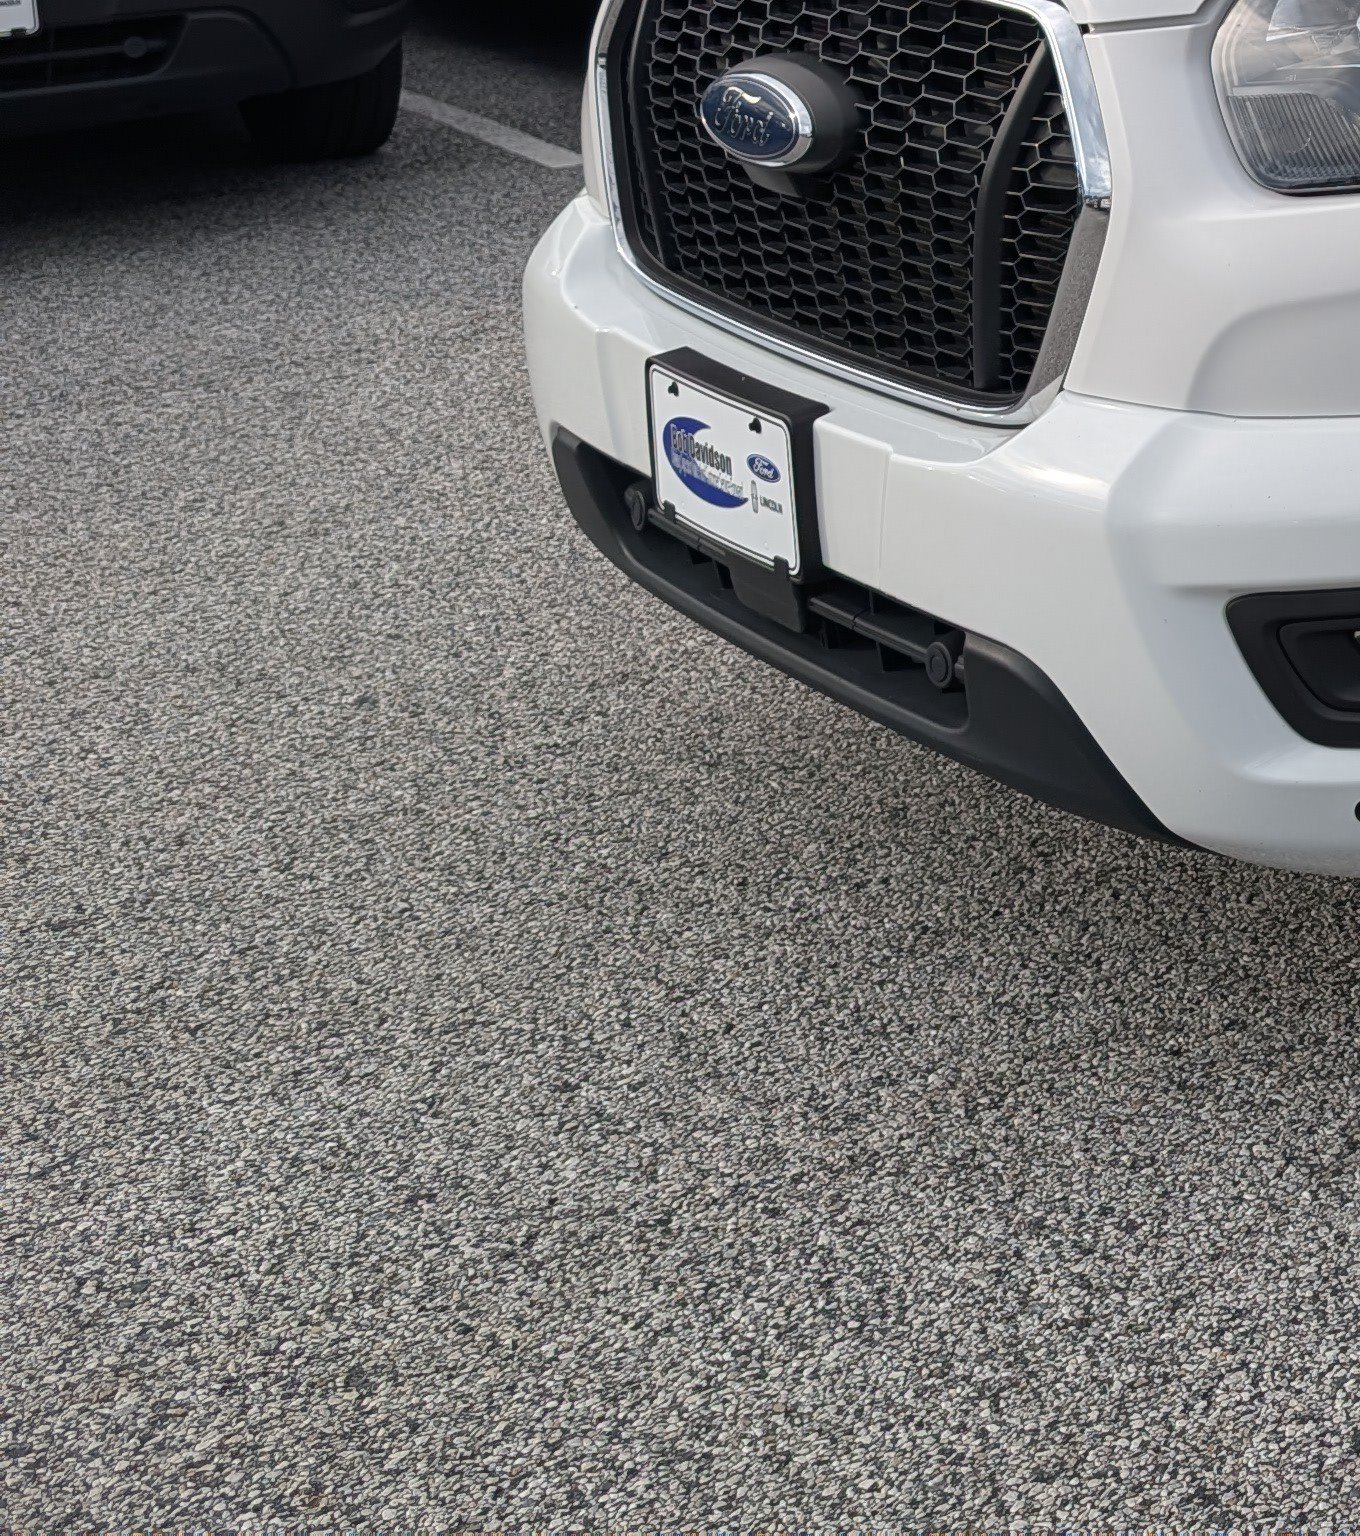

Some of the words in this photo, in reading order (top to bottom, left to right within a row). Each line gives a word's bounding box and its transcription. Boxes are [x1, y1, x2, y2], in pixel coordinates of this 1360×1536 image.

[715, 86, 773, 146] Ford
[670, 423, 689, 454] Bob
[689, 433, 732, 476] Davidson
[759, 495, 783, 514] LINCOLN
